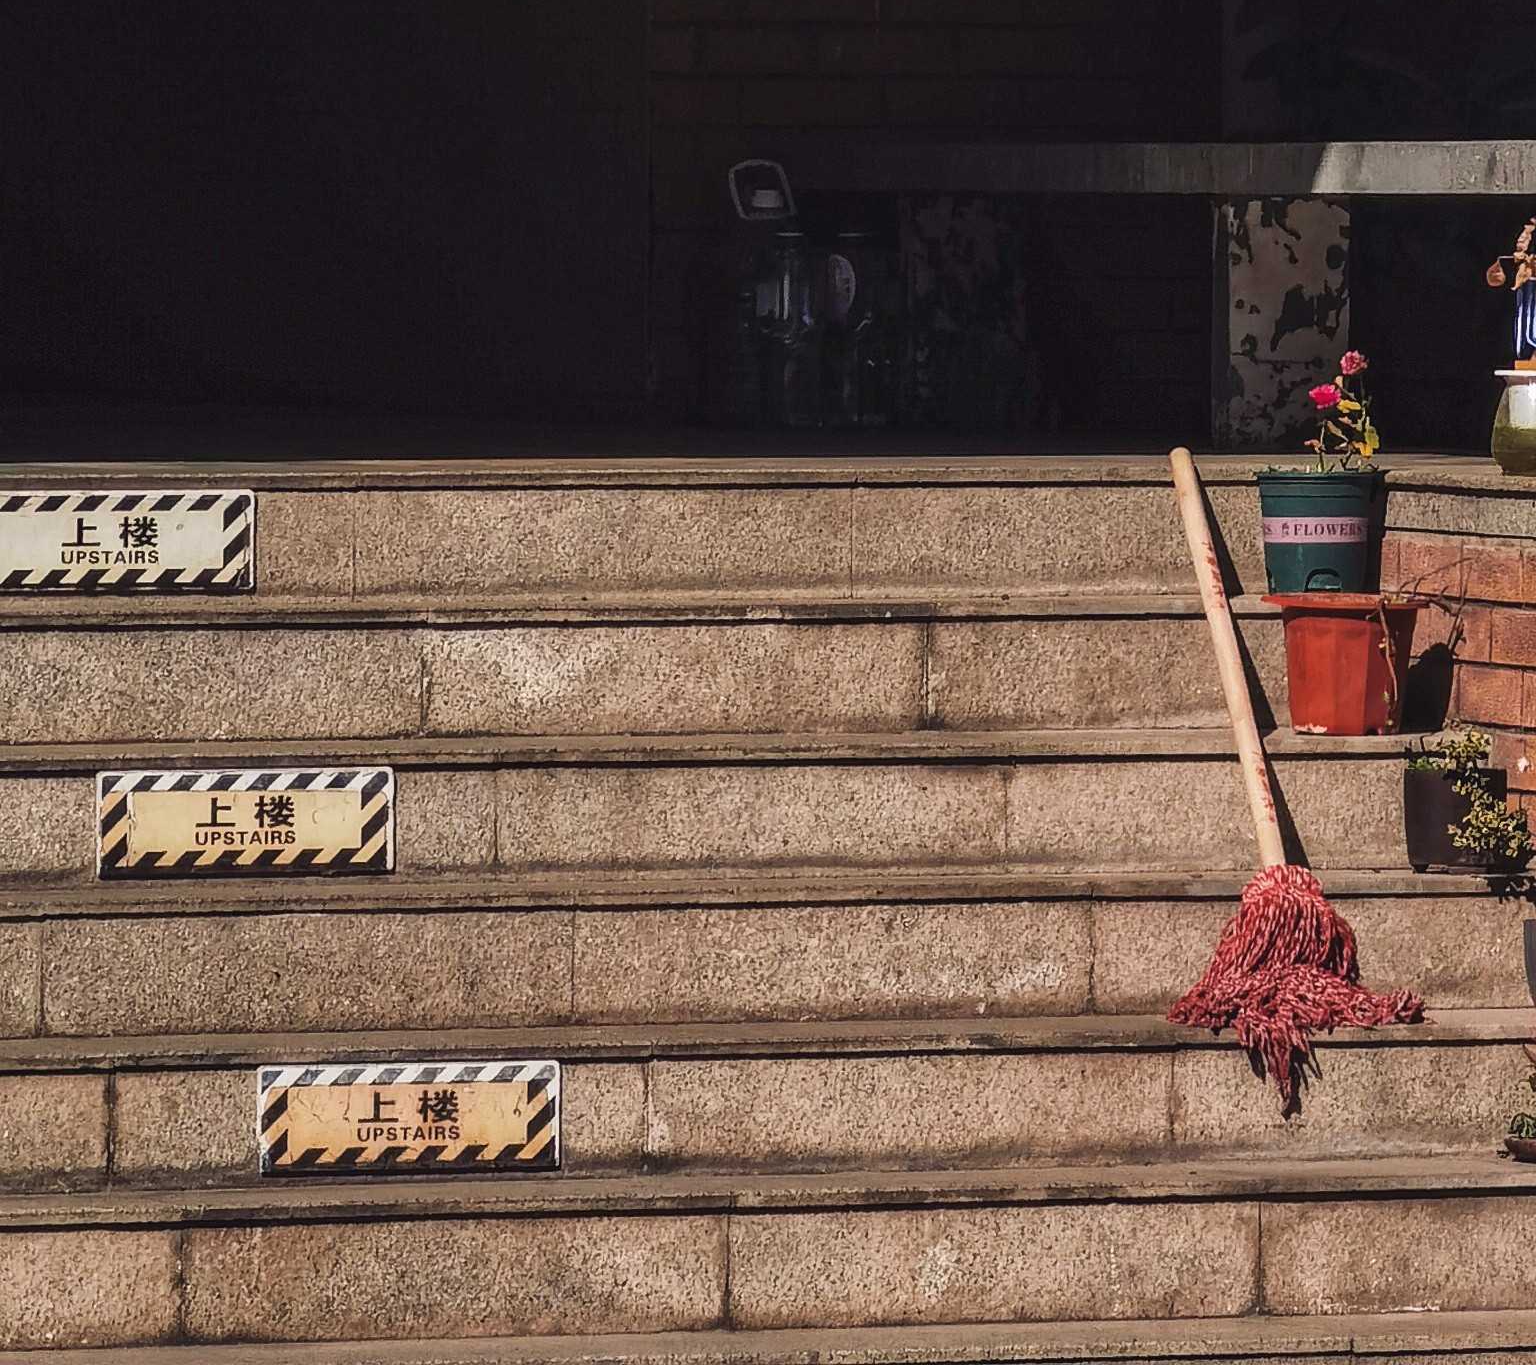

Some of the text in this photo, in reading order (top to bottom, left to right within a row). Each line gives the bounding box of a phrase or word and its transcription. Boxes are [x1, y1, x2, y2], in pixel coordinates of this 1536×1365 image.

[61, 516, 158, 548] 上楼
[61, 550, 159, 565] UPSTAIRS
[195, 795, 295, 829] 上楼
[195, 831, 296, 846] UPSTAIRS
[357, 1089, 459, 1124] 上楼
[357, 1125, 460, 1142] UPSTAIRS
